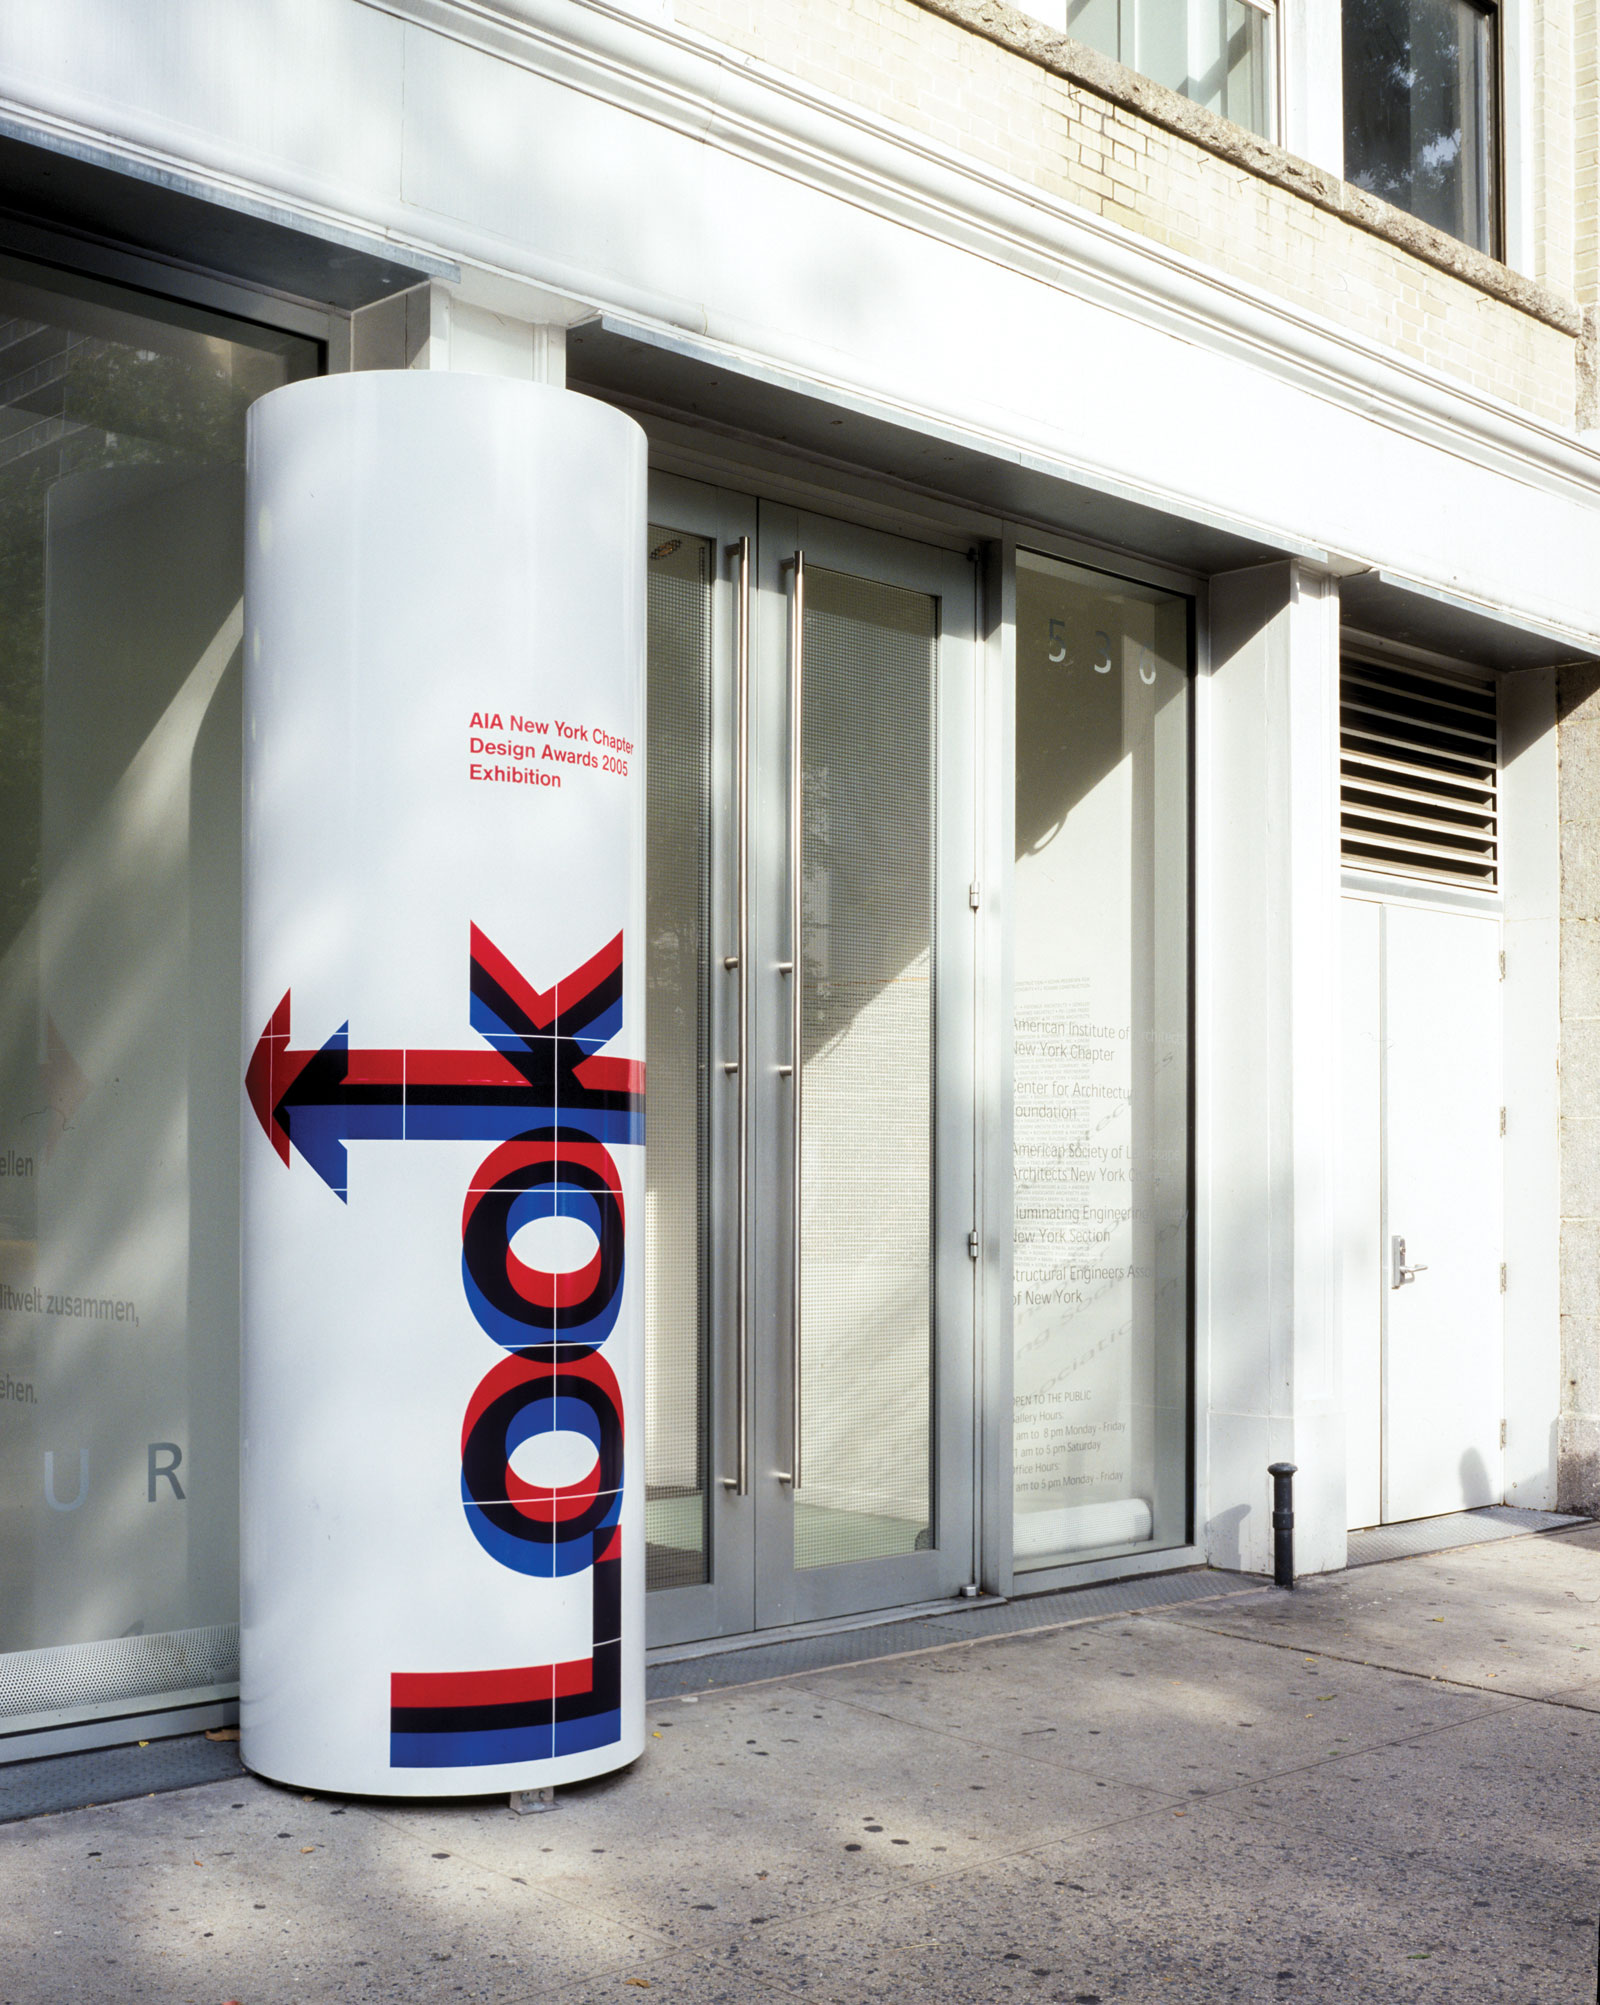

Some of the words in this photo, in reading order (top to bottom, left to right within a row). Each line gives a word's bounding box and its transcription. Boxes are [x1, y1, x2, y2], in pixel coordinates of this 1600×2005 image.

[469, 712, 503, 730] AIA
[510, 715, 549, 735] New
[554, 720, 588, 742] York
[592, 728, 634, 755] Chapter
[470, 737, 535, 760] Design
[541, 744, 598, 768] Awards
[602, 755, 628, 777] 2005
[470, 764, 561, 788] Exhibition
[1069, 1021, 1116, 1039] Institute
[1118, 1026, 1131, 1040] of
[1040, 1042, 1067, 1058] York
[1070, 1044, 1115, 1064] Chapter
[1013, 1079, 1048, 1095] enter
[1052, 1081, 1069, 1097] for
[1072, 1082, 1134, 1100] Architectu
[1015, 1104, 1077, 1120] oundation
[1069, 1143, 1107, 1163] Society
[1111, 1145, 1122, 1159] of
[1070, 1167, 1096, 1182] New
[1099, 1168, 1125, 1183] York
[1015, 1205, 1080, 1224] luminating
[1039, 1228, 1066, 1243] York
[1069, 1228, 1111, 1243] Section
[1012, 1266, 1066, 1282] tructural
[1070, 1265, 1125, 1285] Engineers
[1025, 1290, 1052, 1305] New
[1055, 1289, 1083, 1305] York
[46, 1295, 139, 1328] zusammen,
[285, 919, 646, 1768] Look
[1013, 1395, 1032, 1407] PEN
[1034, 1394, 1045, 1405] TO
[1047, 1393, 1062, 1404] THE
[1064, 1390, 1092, 1403] PUBLIC
[1030, 1429, 1039, 1440] to
[1050, 1428, 1064, 1440] pm
[1065, 1423, 1097, 1438] Monday
[1103, 1421, 1126, 1434] Friday
[1035, 1446, 1044, 1456] to
[1052, 1445, 1066, 1457] pm
[1067, 1440, 1101, 1454] Saturday
[1030, 1481, 1039, 1491] to
[1048, 1480, 1061, 1491] pm
[1062, 1475, 1094, 1488] Monday
[1100, 1471, 1124, 1483] Friday
